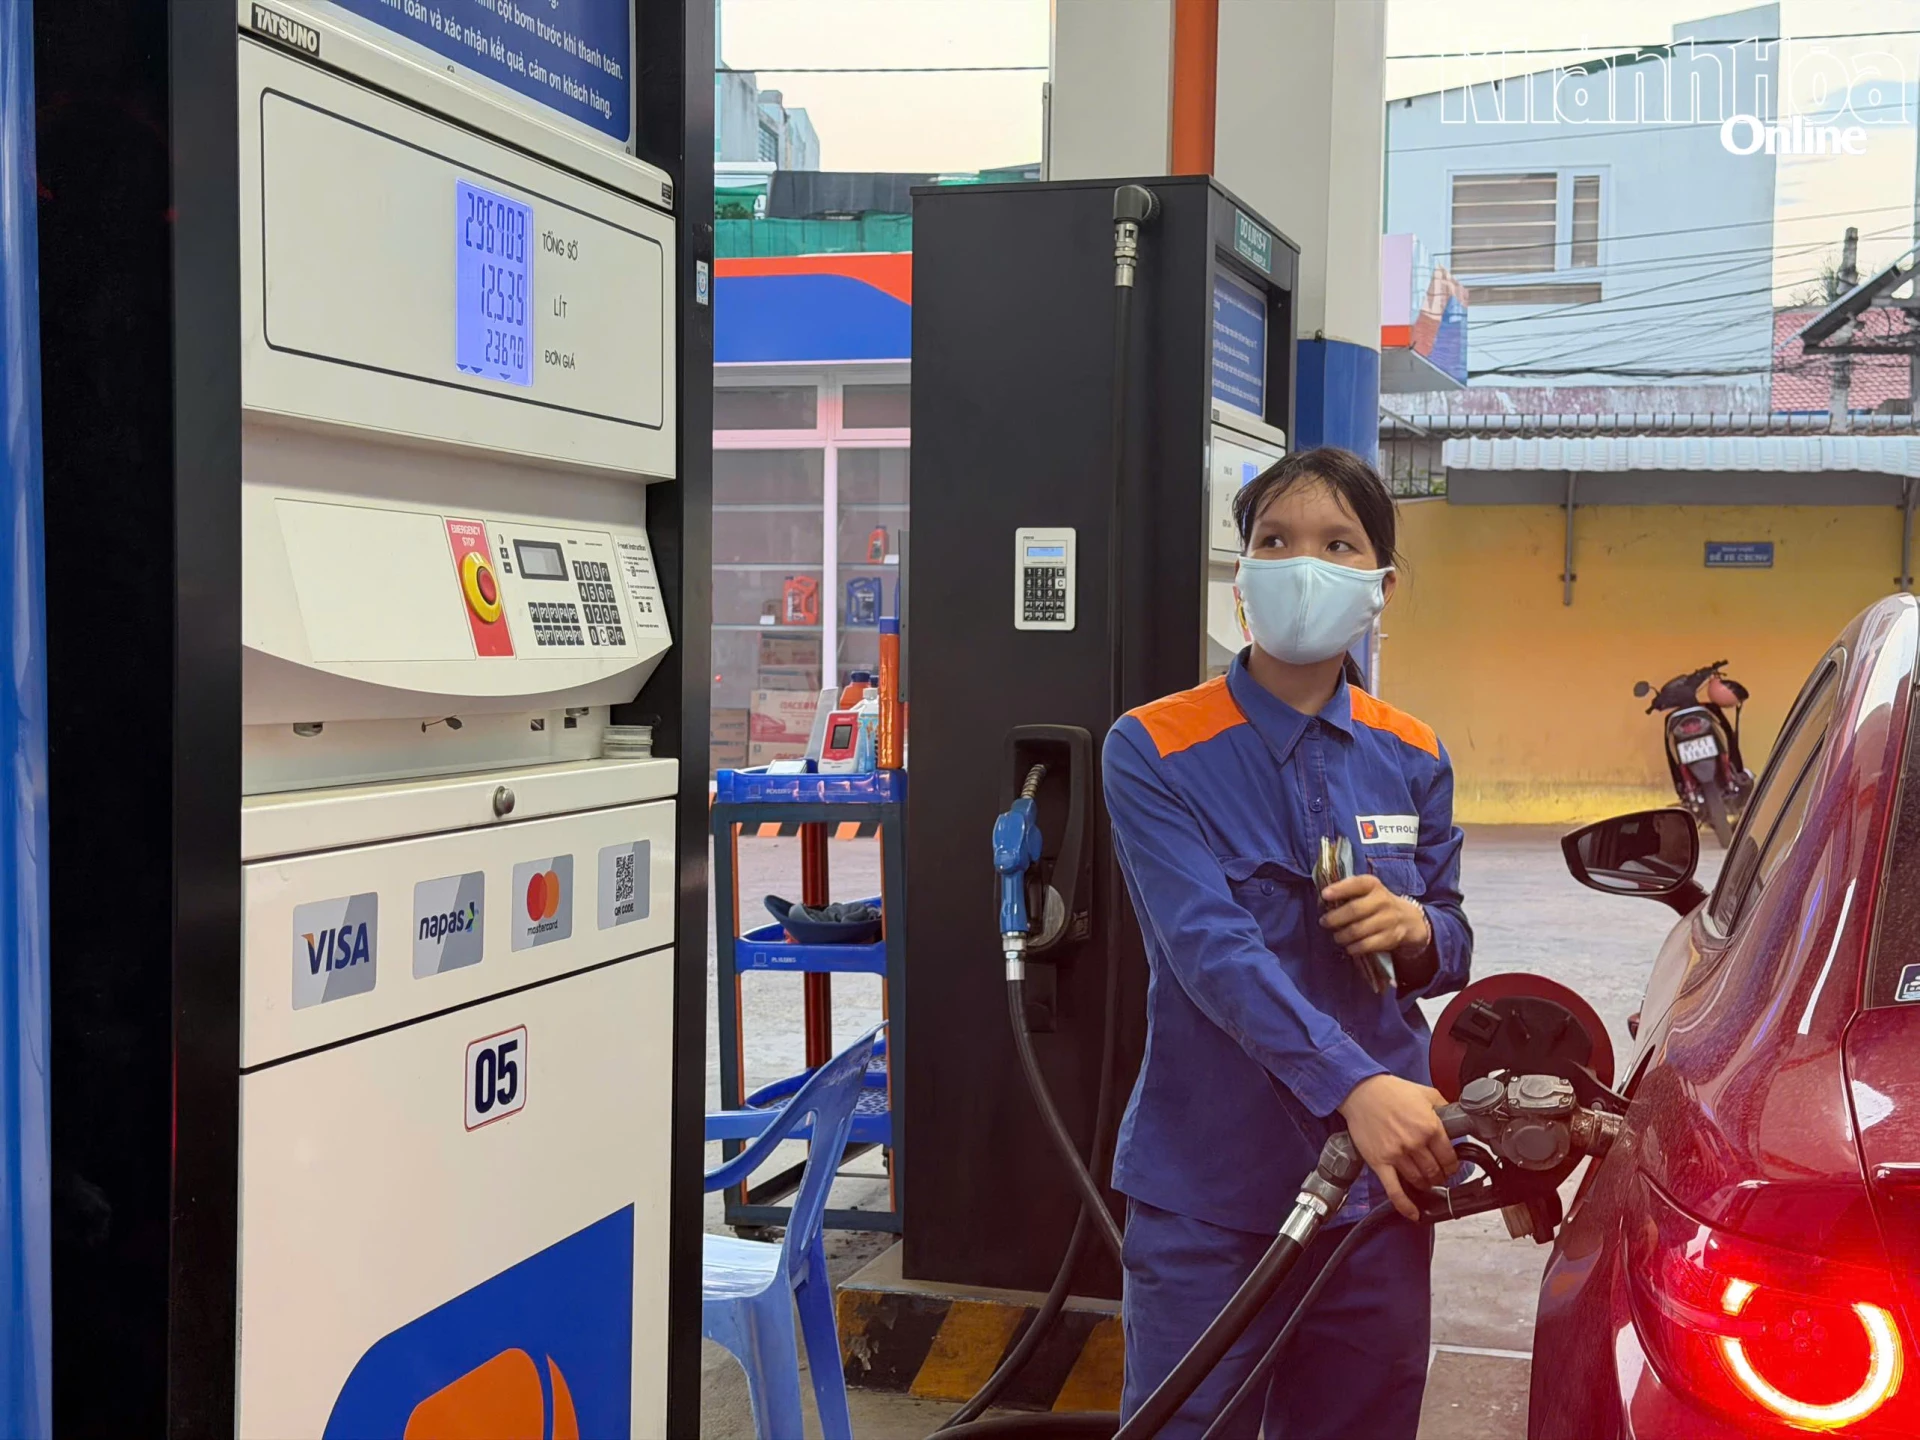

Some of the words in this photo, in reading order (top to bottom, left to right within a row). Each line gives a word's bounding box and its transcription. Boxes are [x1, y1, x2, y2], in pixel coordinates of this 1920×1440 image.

[255, 6, 317, 52] TATSUNO
[498, 0, 512, 23] cột
[515, 4, 535, 33] bơm
[537, 18, 561, 47] trước
[564, 31, 576, 55] khi
[578, 39, 601, 68] thanh
[603, 54, 623, 80] toán.
[404, 0, 427, 24] toán
[430, 8, 441, 31] và
[444, 16, 462, 41] xác
[464, 26, 488, 55] nhận
[491, 36, 505, 63] kết
[507, 51, 526, 77] quả,
[528, 59, 547, 84] cảm
[549, 72, 561, 91] ơn
[564, 74, 588, 104] khách
[590, 88, 612, 119] hàng.
[466, 192, 524, 263] 296703
[542, 231, 564, 256] TỔNG
[568, 240, 578, 261] SỐ
[554, 295, 567, 319] LÍT
[486, 328, 524, 370] 23670
[545, 349, 561, 367] ĐƠN
[562, 353, 575, 370] GIÁ
[451, 524, 480, 535] EMERGENCY
[462, 537, 475, 546] STOP
[575, 564, 580, 578] 7
[584, 564, 590, 578] 8
[593, 564, 599, 578] 9
[581, 585, 587, 600] 4
[589, 586, 595, 600] 5
[598, 586, 605, 600] 6
[586, 607, 591, 621] 1
[594, 608, 601, 621] 2
[603, 608, 609, 621] 3
[591, 629, 597, 643] 0
[600, 629, 607, 643] C
[614, 905, 623, 916] QR
[623, 903, 634, 914] CODE
[419, 910, 464, 944] napas
[526, 920, 558, 936] mastercard
[302, 922, 370, 975] VISA
[475, 1039, 518, 1114] 05
